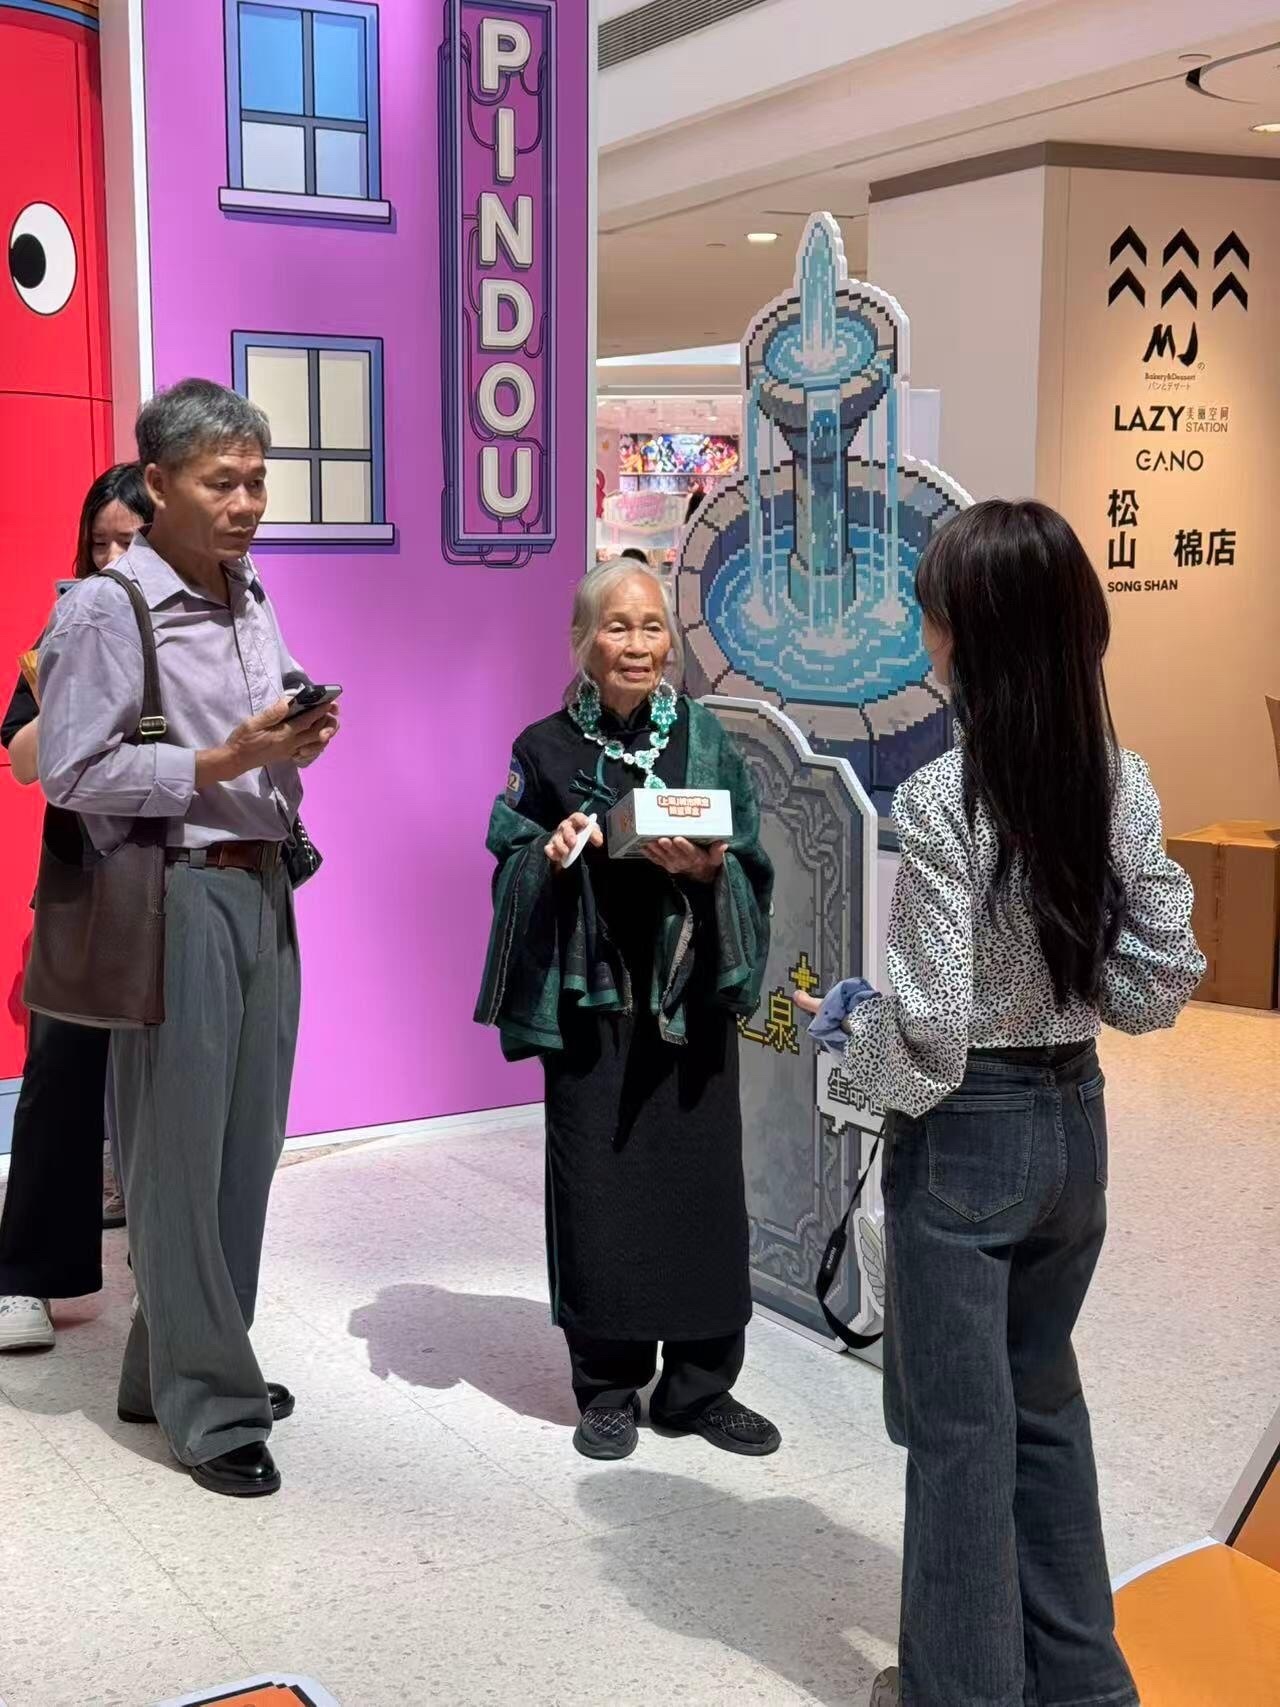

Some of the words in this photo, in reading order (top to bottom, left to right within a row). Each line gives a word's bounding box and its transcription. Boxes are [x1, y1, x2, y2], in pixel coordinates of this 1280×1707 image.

[479, 17, 536, 519] PINDOU
[1114, 405, 1185, 432] LAZY
[1186, 422, 1228, 433] STATION
[1108, 580, 1143, 593] SONG
[1144, 579, 1178, 592] SHAN
